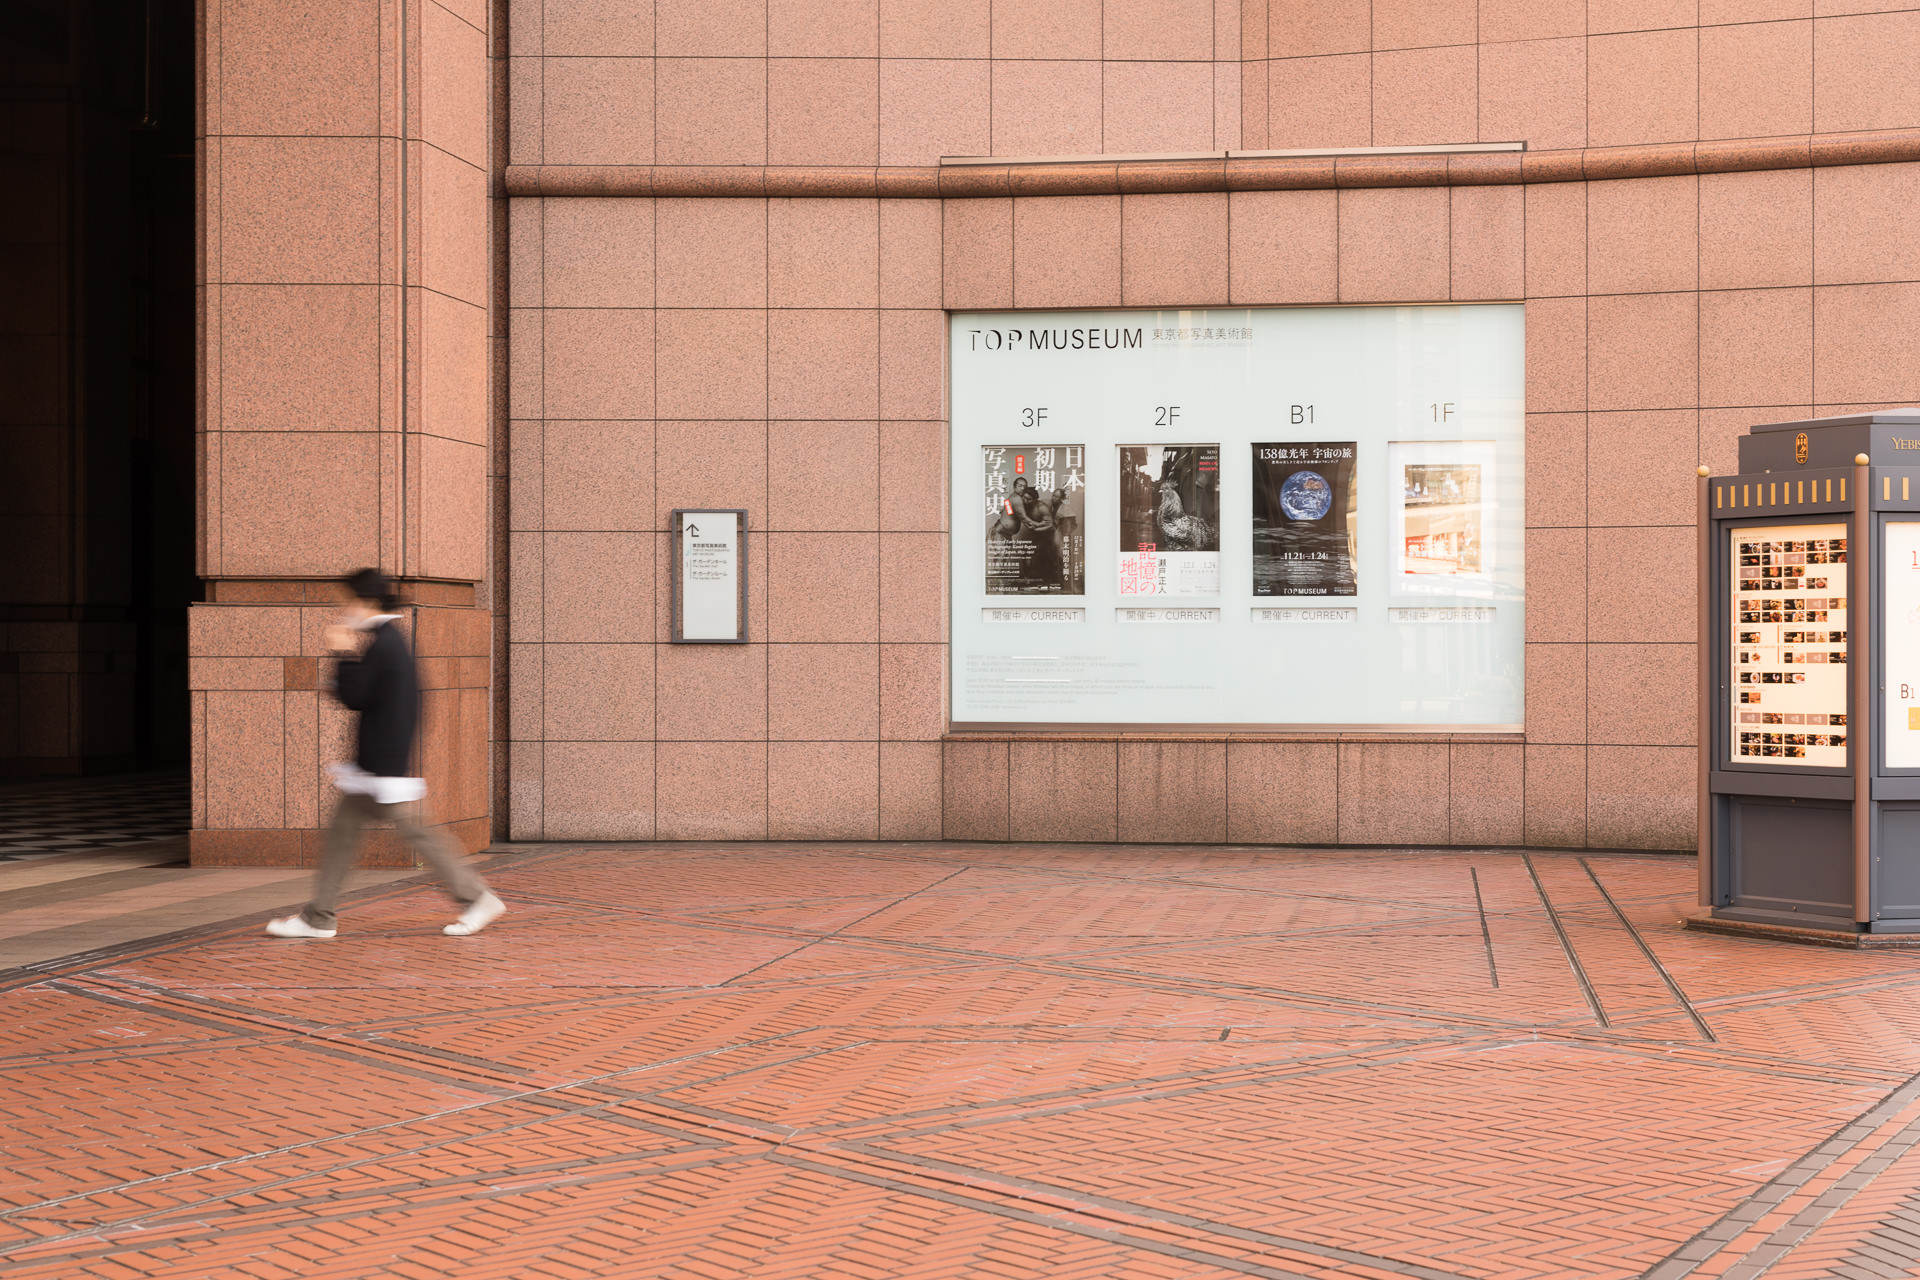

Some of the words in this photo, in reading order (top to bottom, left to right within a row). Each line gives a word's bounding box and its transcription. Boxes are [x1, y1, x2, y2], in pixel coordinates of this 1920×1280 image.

[1029, 328, 1143, 350] MUSEUM
[1152, 327, 1254, 341] 東京都写真美術館
[1022, 408, 1048, 427] 3F
[1155, 406, 1181, 426] 2F
[1291, 405, 1314, 425] B1
[1430, 402, 1455, 422] 1F
[1260, 448, 1309, 459] 138億光年
[1312, 447, 1352, 459] 宇宙の旅
[1034, 447, 1055, 492] 初期
[1063, 446, 1085, 492] 日本
[985, 448, 1006, 516] 写真史
[1120, 558, 1138, 594] 地図
[1138, 542, 1157, 595] 記憶の
[1158, 558, 1167, 594] 瀬戸正人
[992, 611, 1021, 621] 開催中
[1031, 611, 1078, 621] CURRENT
[1126, 611, 1156, 621] 開催中
[1166, 611, 1213, 621] CURRENT
[1262, 611, 1292, 621] 開催中
[1301, 611, 1349, 621] CURRENT
[1439, 611, 1488, 621] CURRENT
[1900, 683, 1915, 699] B1
